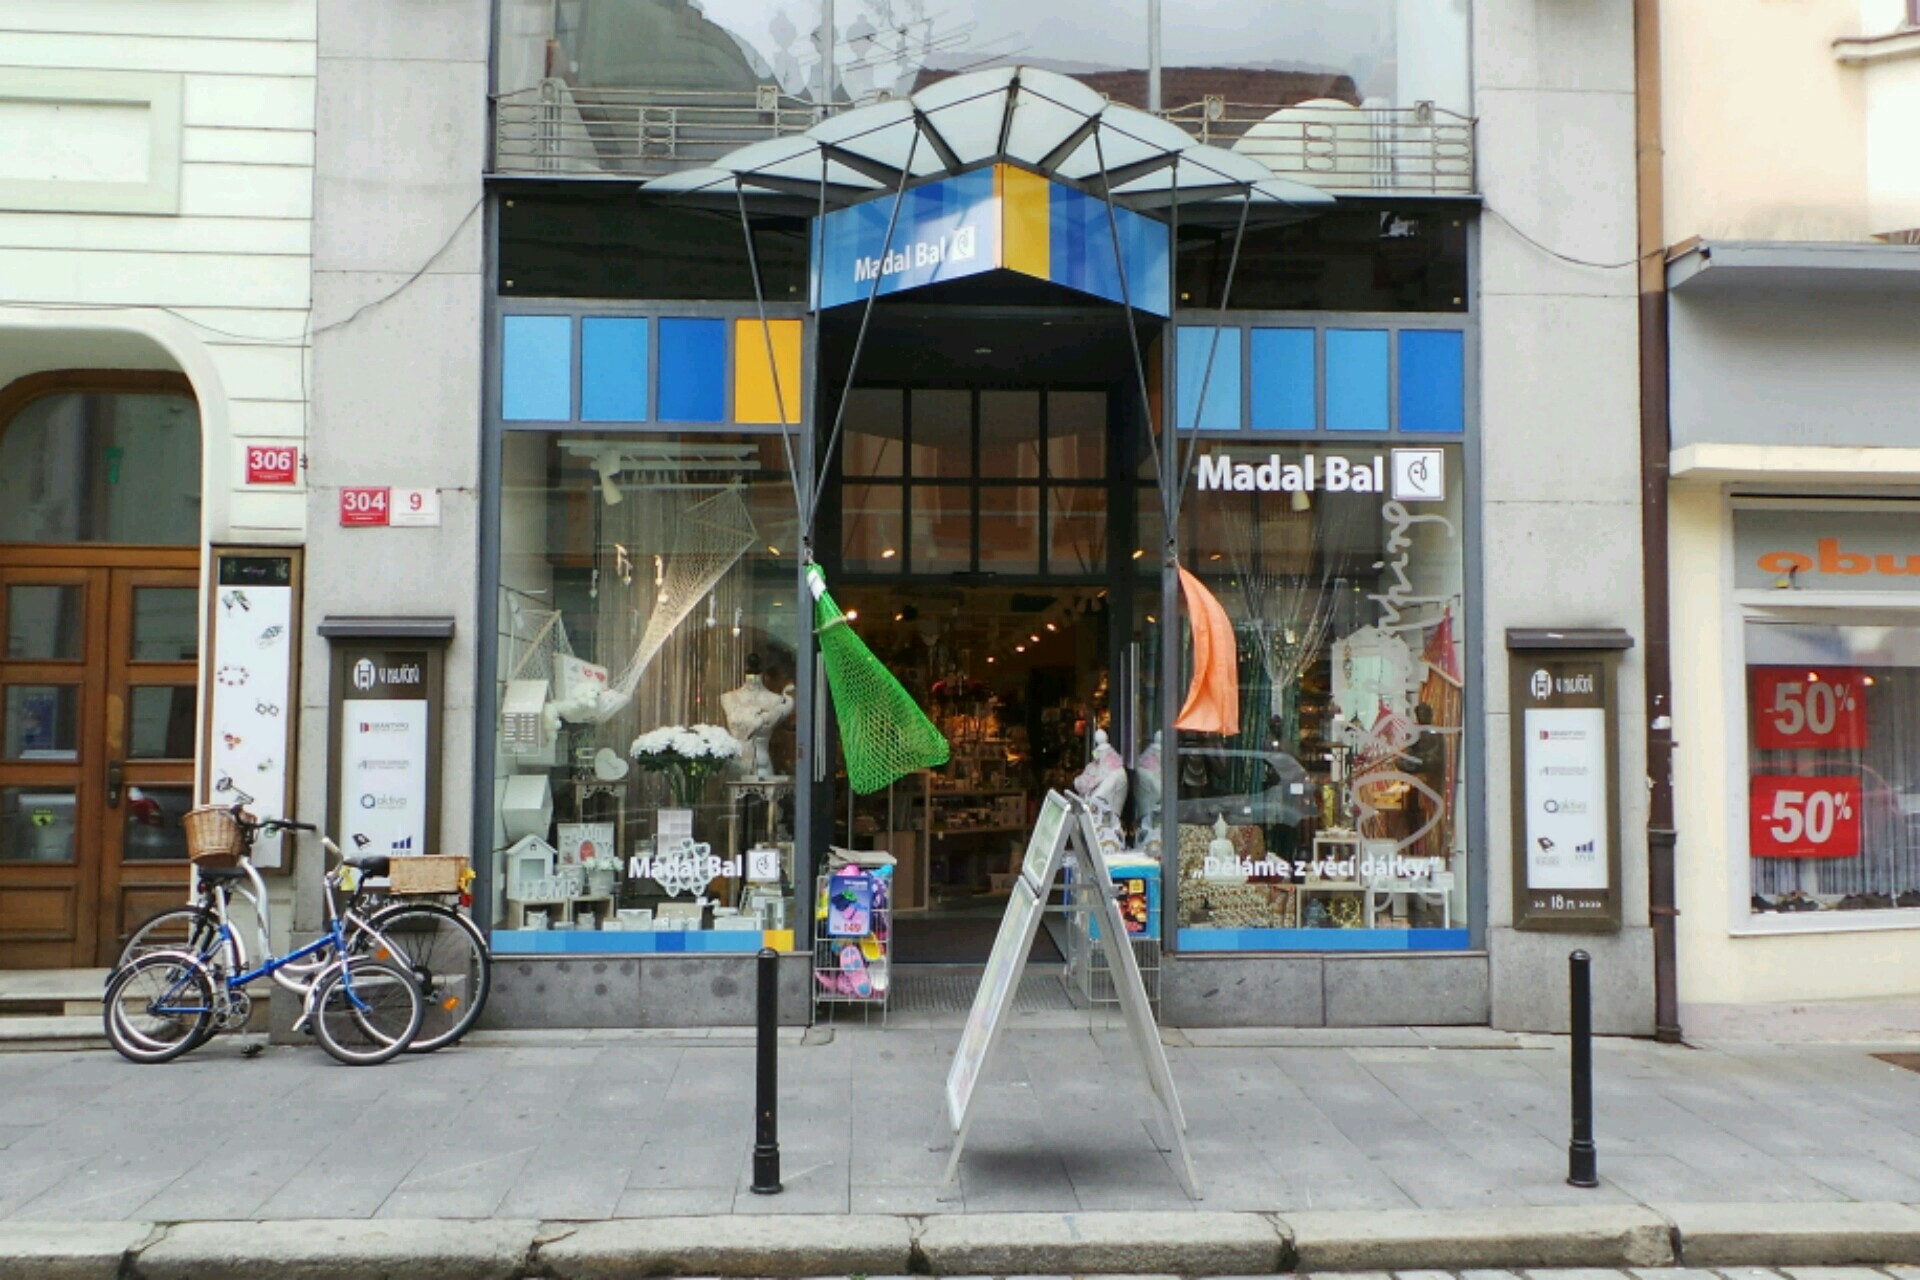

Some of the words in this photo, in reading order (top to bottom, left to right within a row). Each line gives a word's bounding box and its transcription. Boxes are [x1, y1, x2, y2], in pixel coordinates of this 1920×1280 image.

[854, 246, 911, 283] Madal
[915, 237, 946, 268] Bal
[250, 450, 292, 471] 306
[1197, 454, 1315, 492] Madal
[1325, 455, 1384, 492] Bal
[343, 491, 386, 512] 304
[409, 492, 422, 511] 9
[1764, 681, 1855, 735] -50%
[1761, 789, 1853, 844] -50%
[628, 855, 701, 879] Madal
[708, 854, 743, 877] Bal
[1294, 860, 1306, 876] z
[1313, 855, 1356, 876] věcí
[1551, 893, 1564, 911] 18
